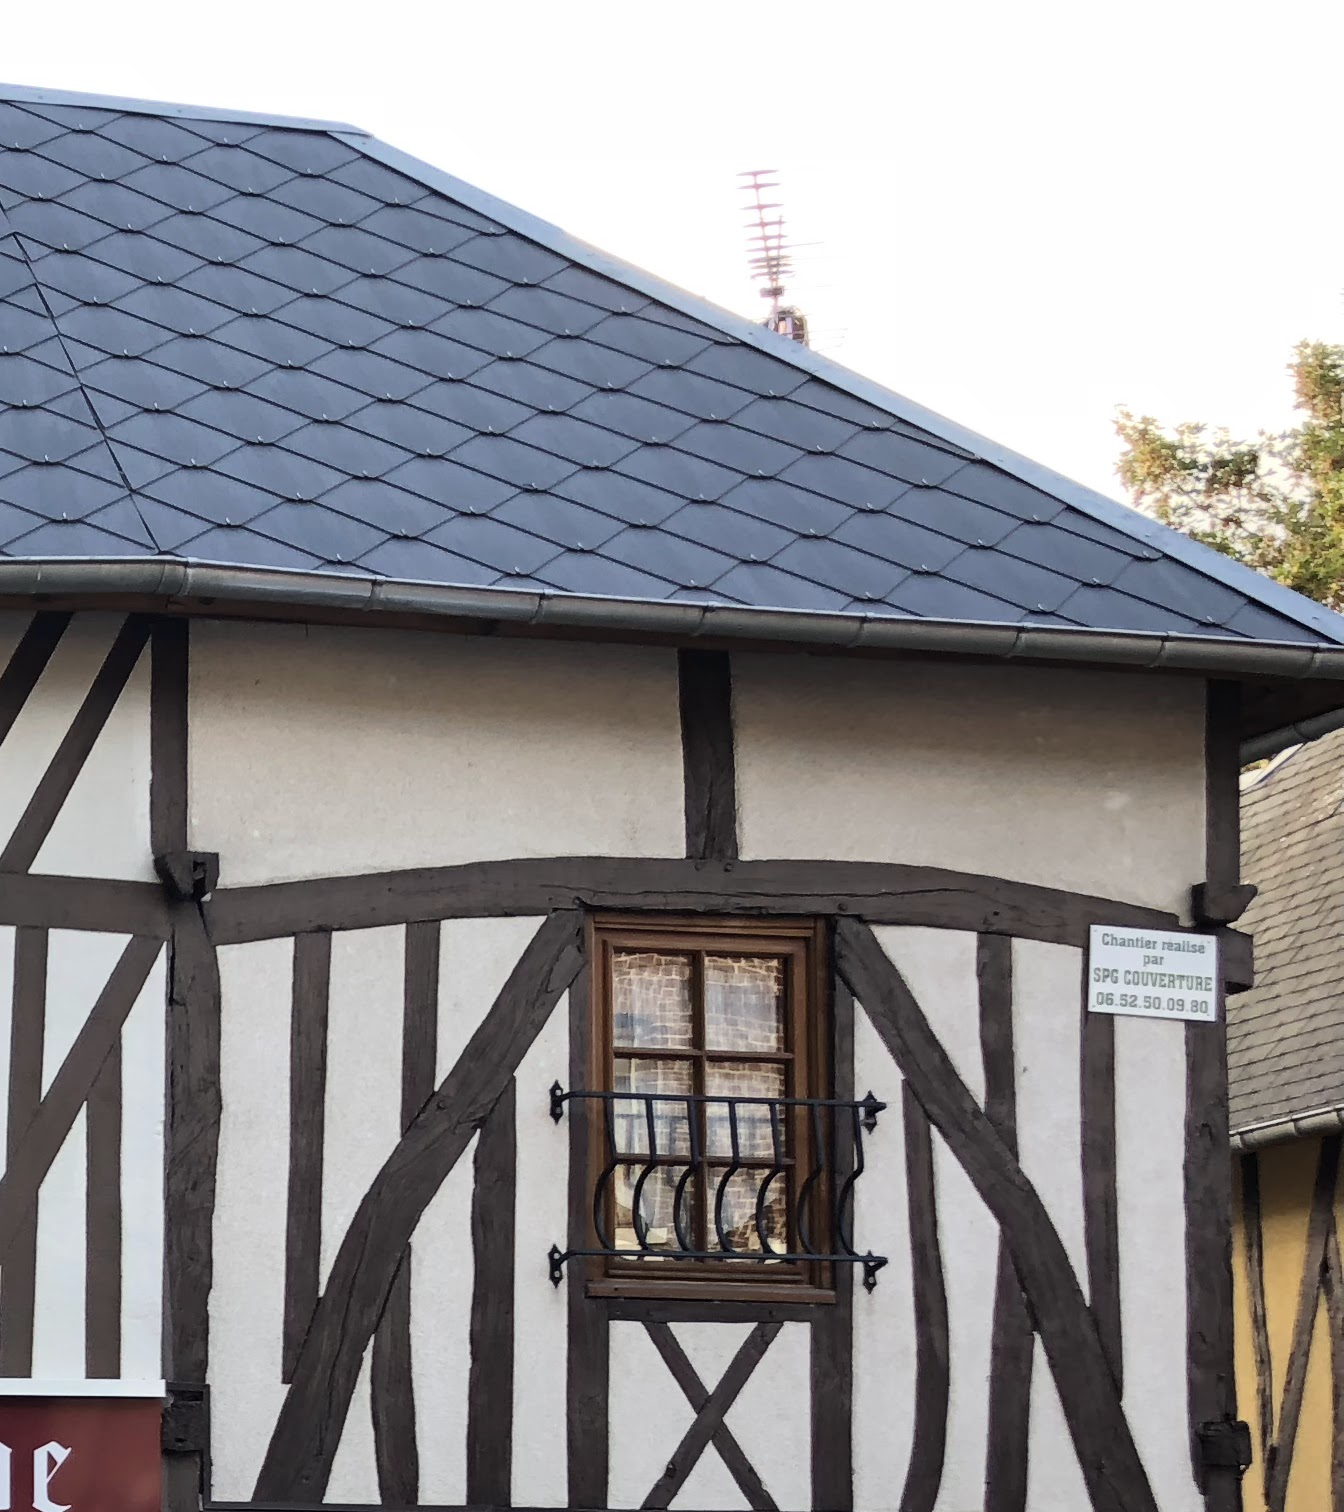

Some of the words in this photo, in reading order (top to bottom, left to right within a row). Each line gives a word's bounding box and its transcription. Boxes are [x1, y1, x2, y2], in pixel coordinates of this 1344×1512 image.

[1102, 932, 1157, 950] Chantier
[1143, 954, 1164, 967] par
[1093, 968, 1119, 985] SPG
[1124, 970, 1212, 992] COUVERTURE
